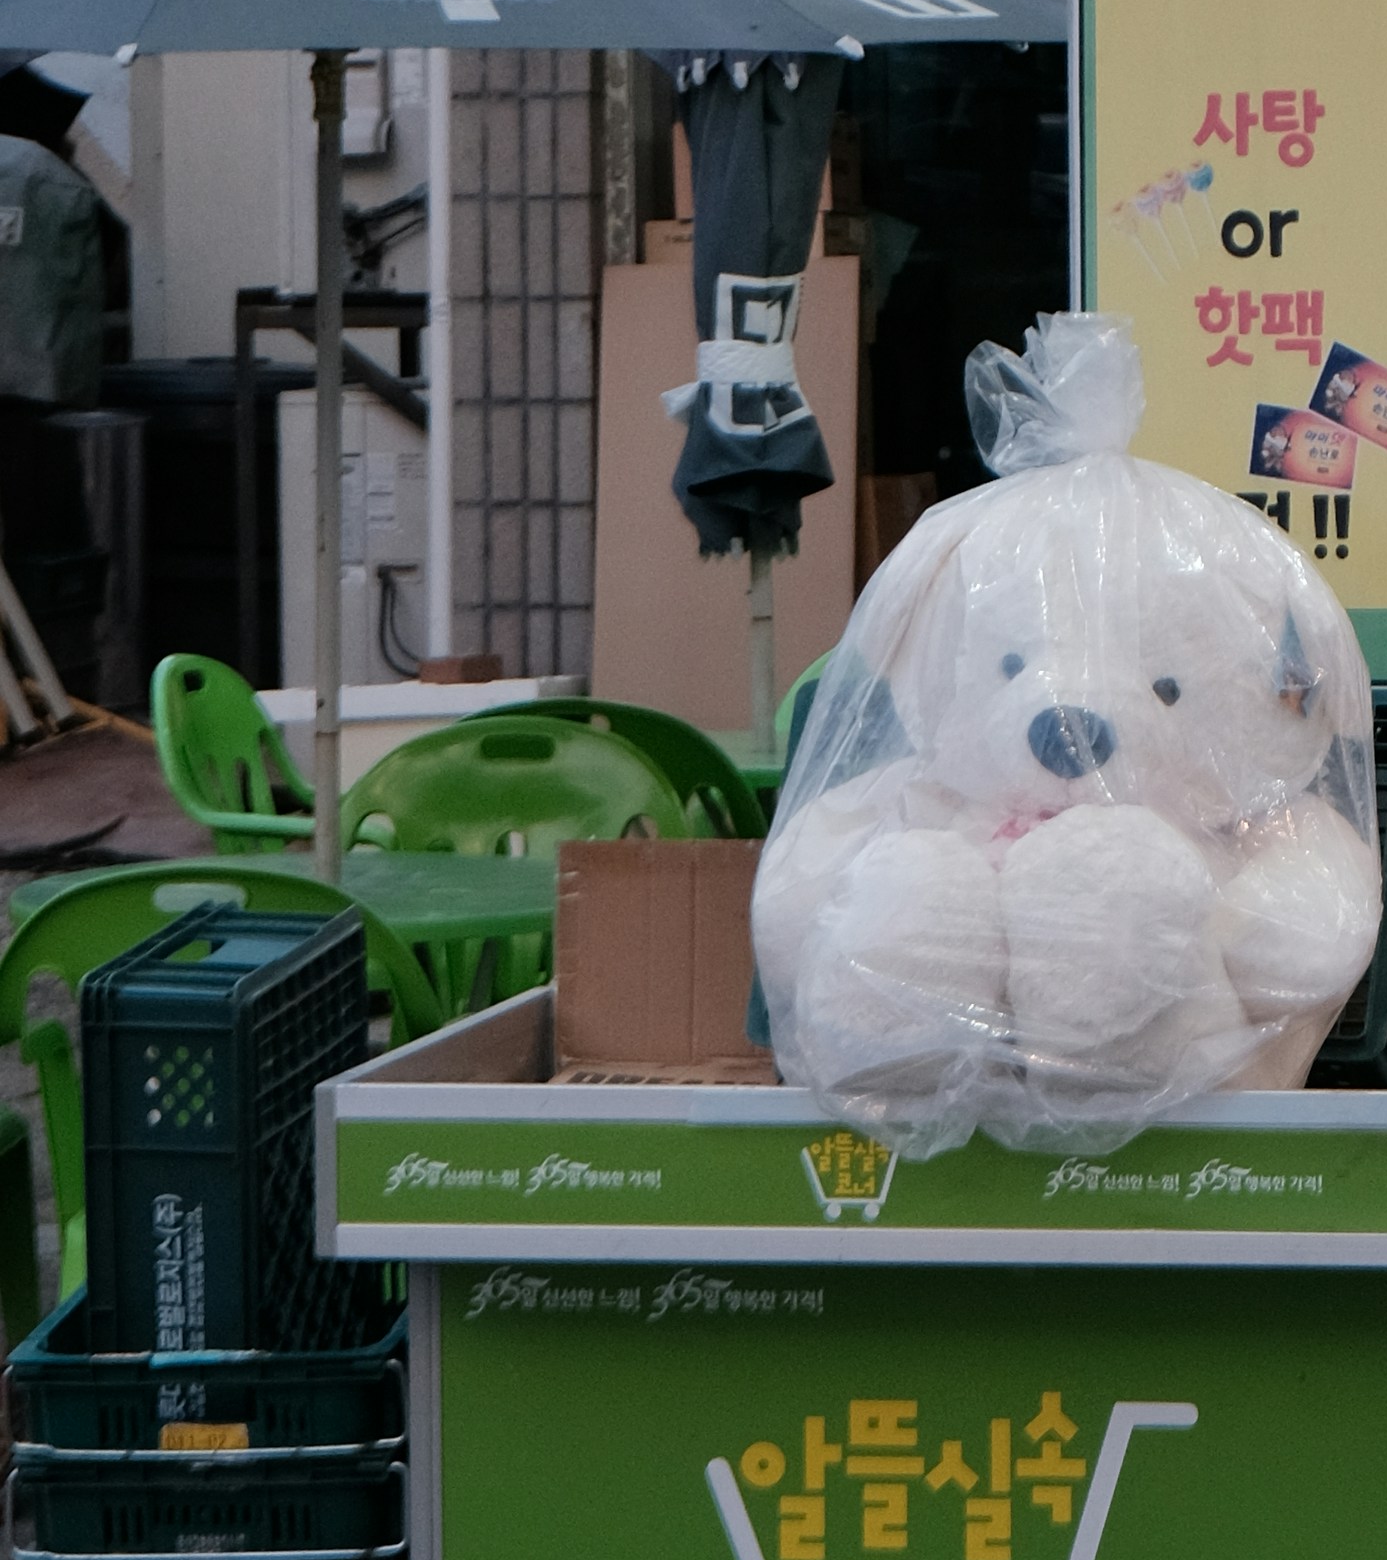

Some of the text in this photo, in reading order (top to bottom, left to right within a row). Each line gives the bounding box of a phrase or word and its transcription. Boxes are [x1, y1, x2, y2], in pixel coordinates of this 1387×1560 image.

[1192, 89, 1326, 168] 사탕
[1220, 207, 1299, 258] or
[1194, 285, 1325, 368] 핫팩
[834, 1172, 877, 1196] 코너
[1042, 1156, 1111, 1200] 365일
[1183, 1158, 1253, 1200] 365일
[462, 1265, 551, 1321] 365일
[645, 1266, 735, 1323] 365일
